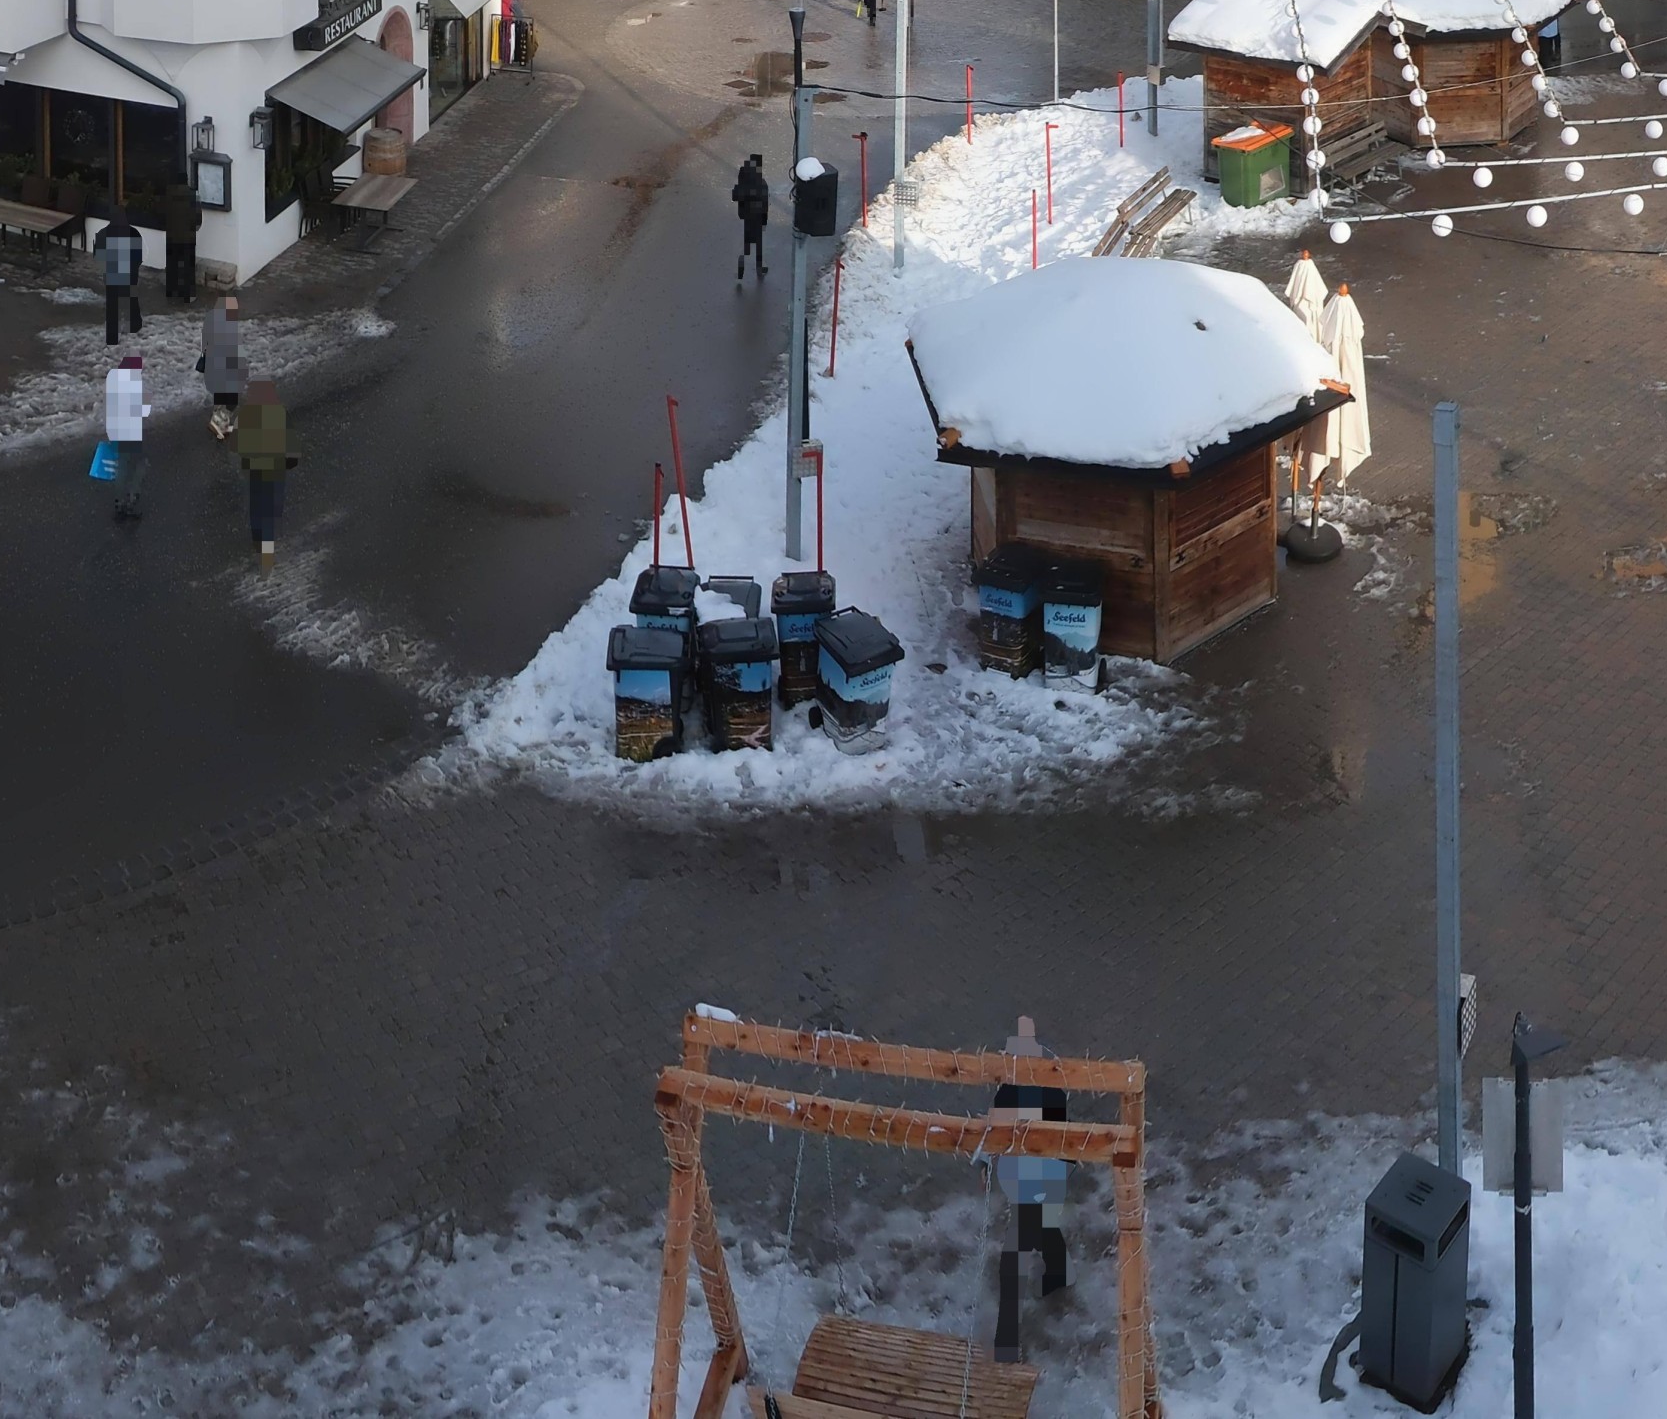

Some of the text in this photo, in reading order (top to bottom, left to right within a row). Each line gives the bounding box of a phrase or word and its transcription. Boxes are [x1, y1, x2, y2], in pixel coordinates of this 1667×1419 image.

[985, 593, 1013, 608] Seefeld
[1052, 611, 1086, 624] Seefeld
[860, 671, 888, 687] Seefeld
